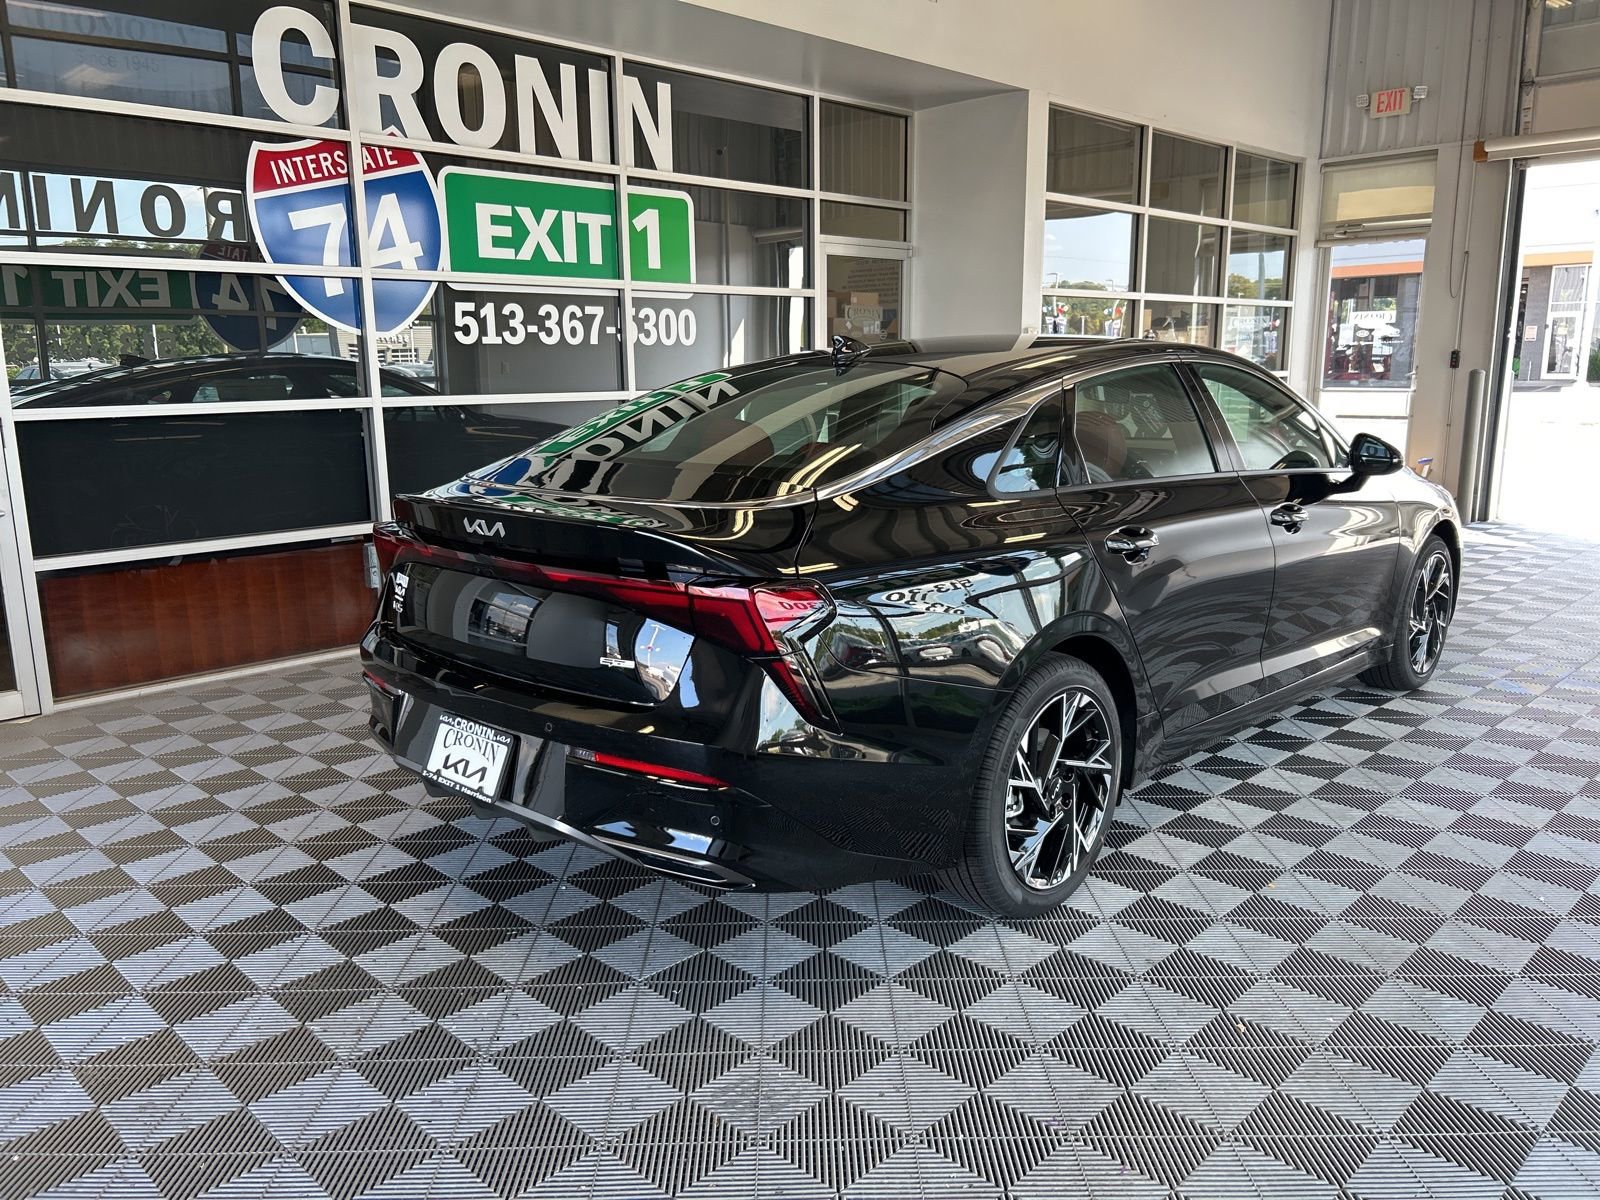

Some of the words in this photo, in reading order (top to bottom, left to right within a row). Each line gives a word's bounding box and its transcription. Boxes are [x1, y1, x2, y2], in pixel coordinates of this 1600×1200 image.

[251, 6, 673, 172] CRONIN
[1376, 88, 1405, 114] EXIT
[270, 146, 398, 186] INTERSATE
[288, 193, 424, 298] 74
[475, 202, 612, 266] EXIT
[631, 208, 661, 270] 1
[463, 516, 506, 538] KIA
[454, 717, 495, 741] CRONIN
[443, 728, 501, 767] CRONIN
[442, 753, 488, 783] KIA
[438, 776, 456, 788] EXIT
[461, 786, 492, 804] Harrison
